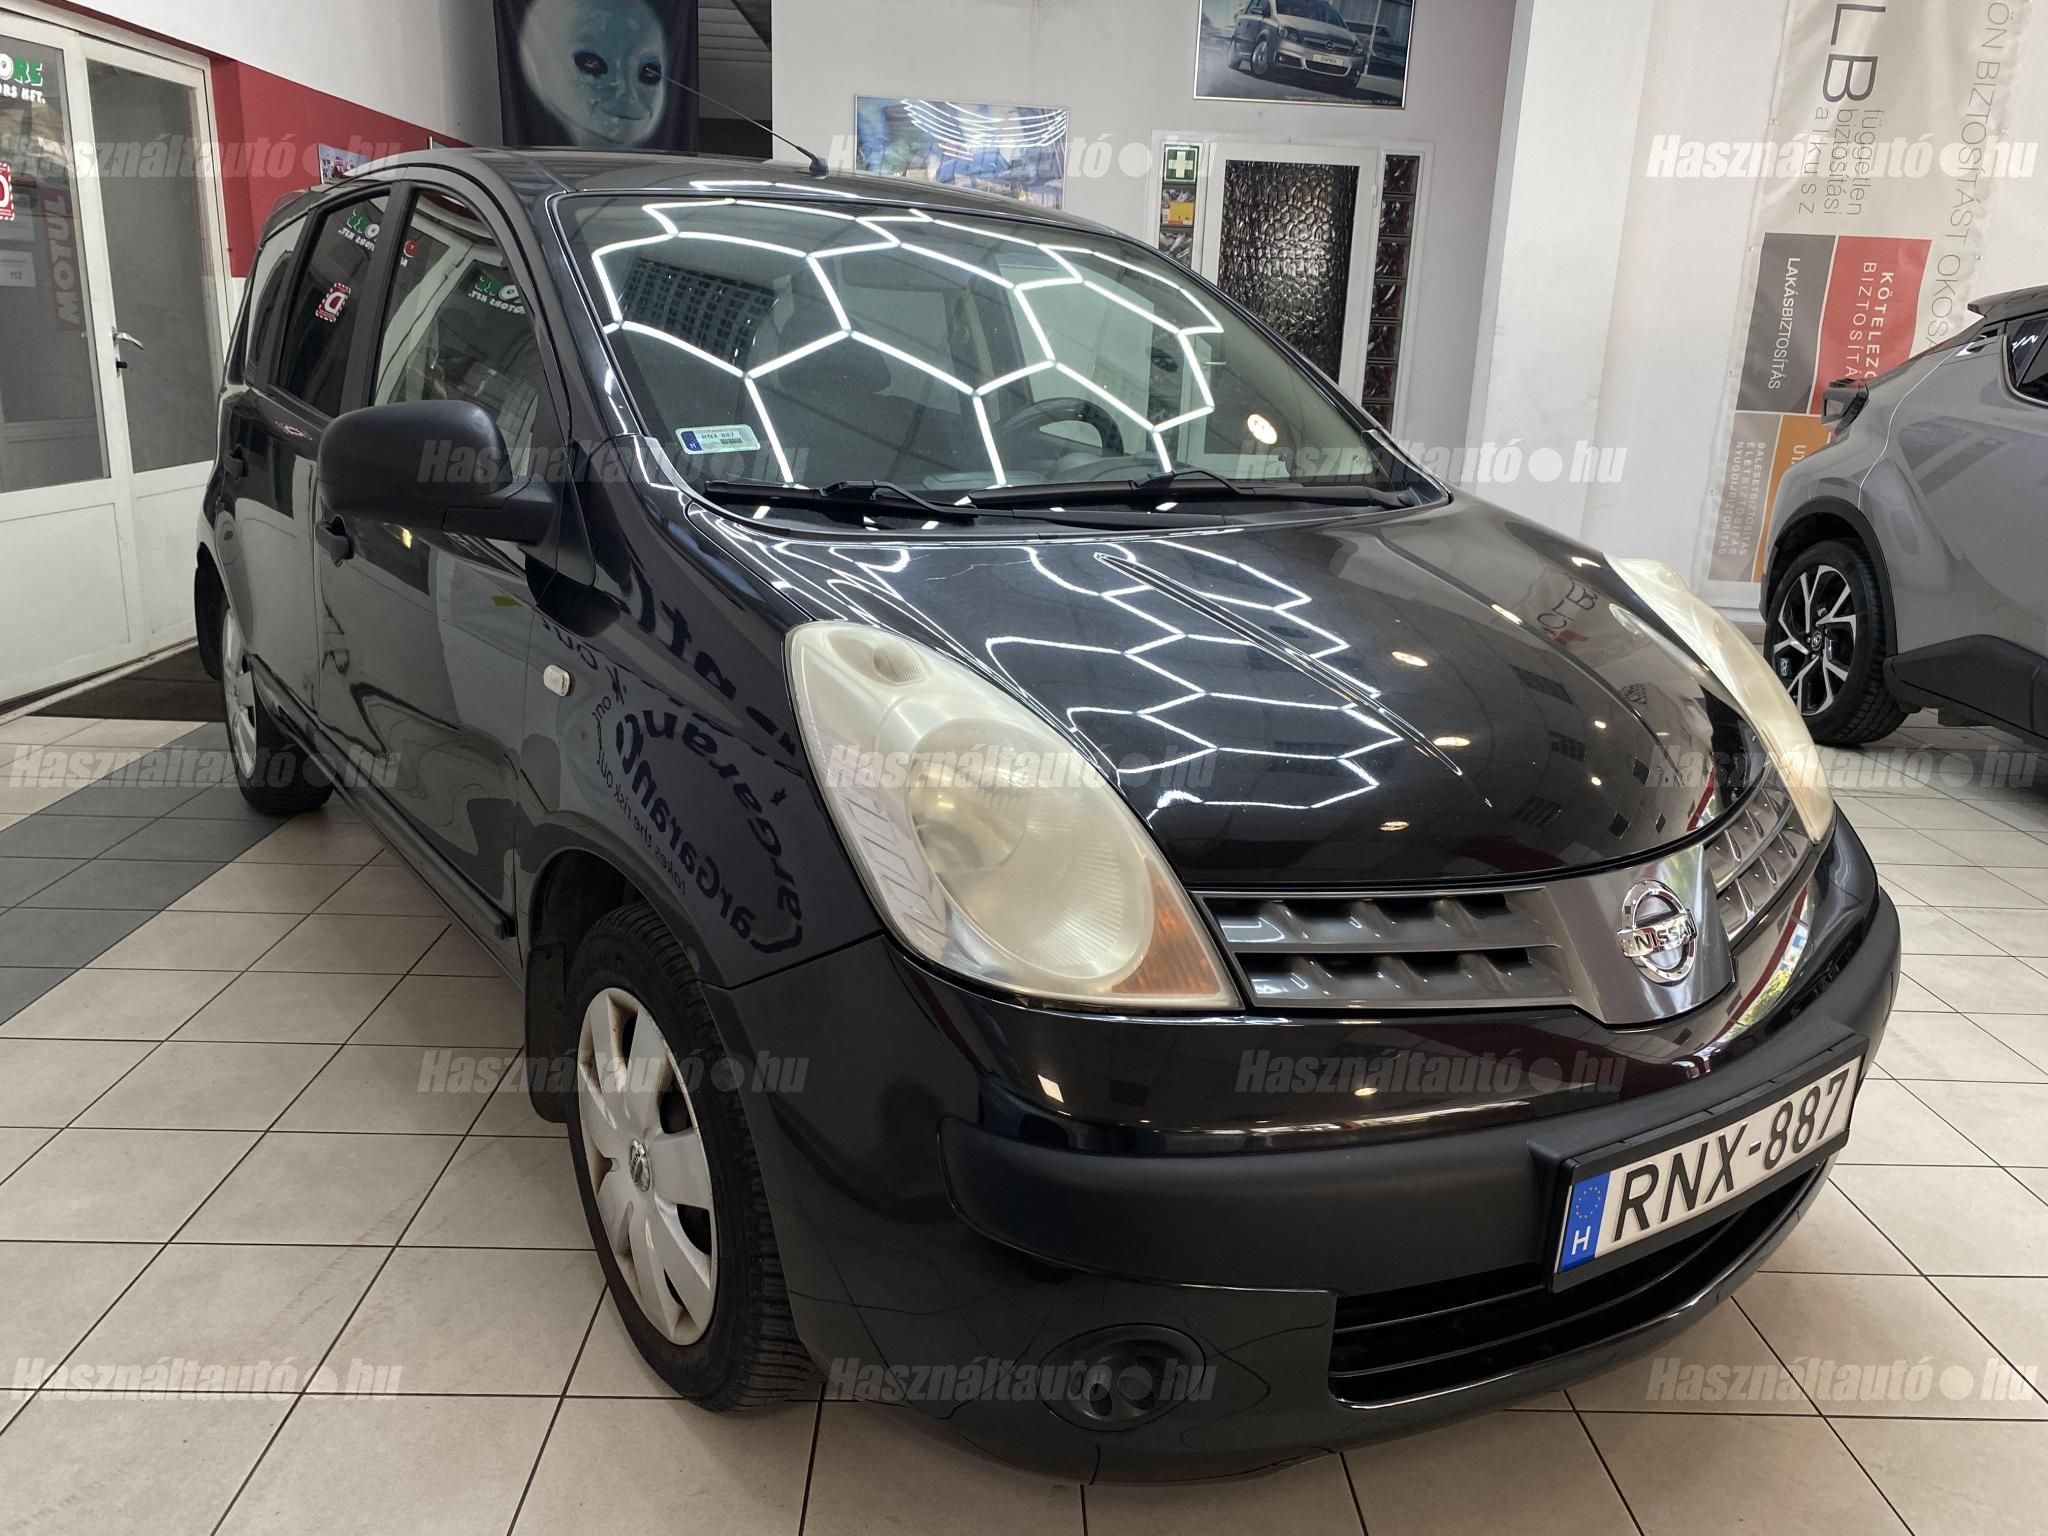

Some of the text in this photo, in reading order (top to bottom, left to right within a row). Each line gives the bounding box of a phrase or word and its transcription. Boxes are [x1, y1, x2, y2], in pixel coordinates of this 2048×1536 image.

[1946, 60, 2001, 246] BIZTOSÍTÁST
[1768, 257, 1801, 390] LAKÁSBIZTOSÍTÁS
[1633, 915, 1696, 951] NISSAN
[1613, 1067, 1850, 1242] RNX-887
[1571, 1226, 1591, 1255] H
